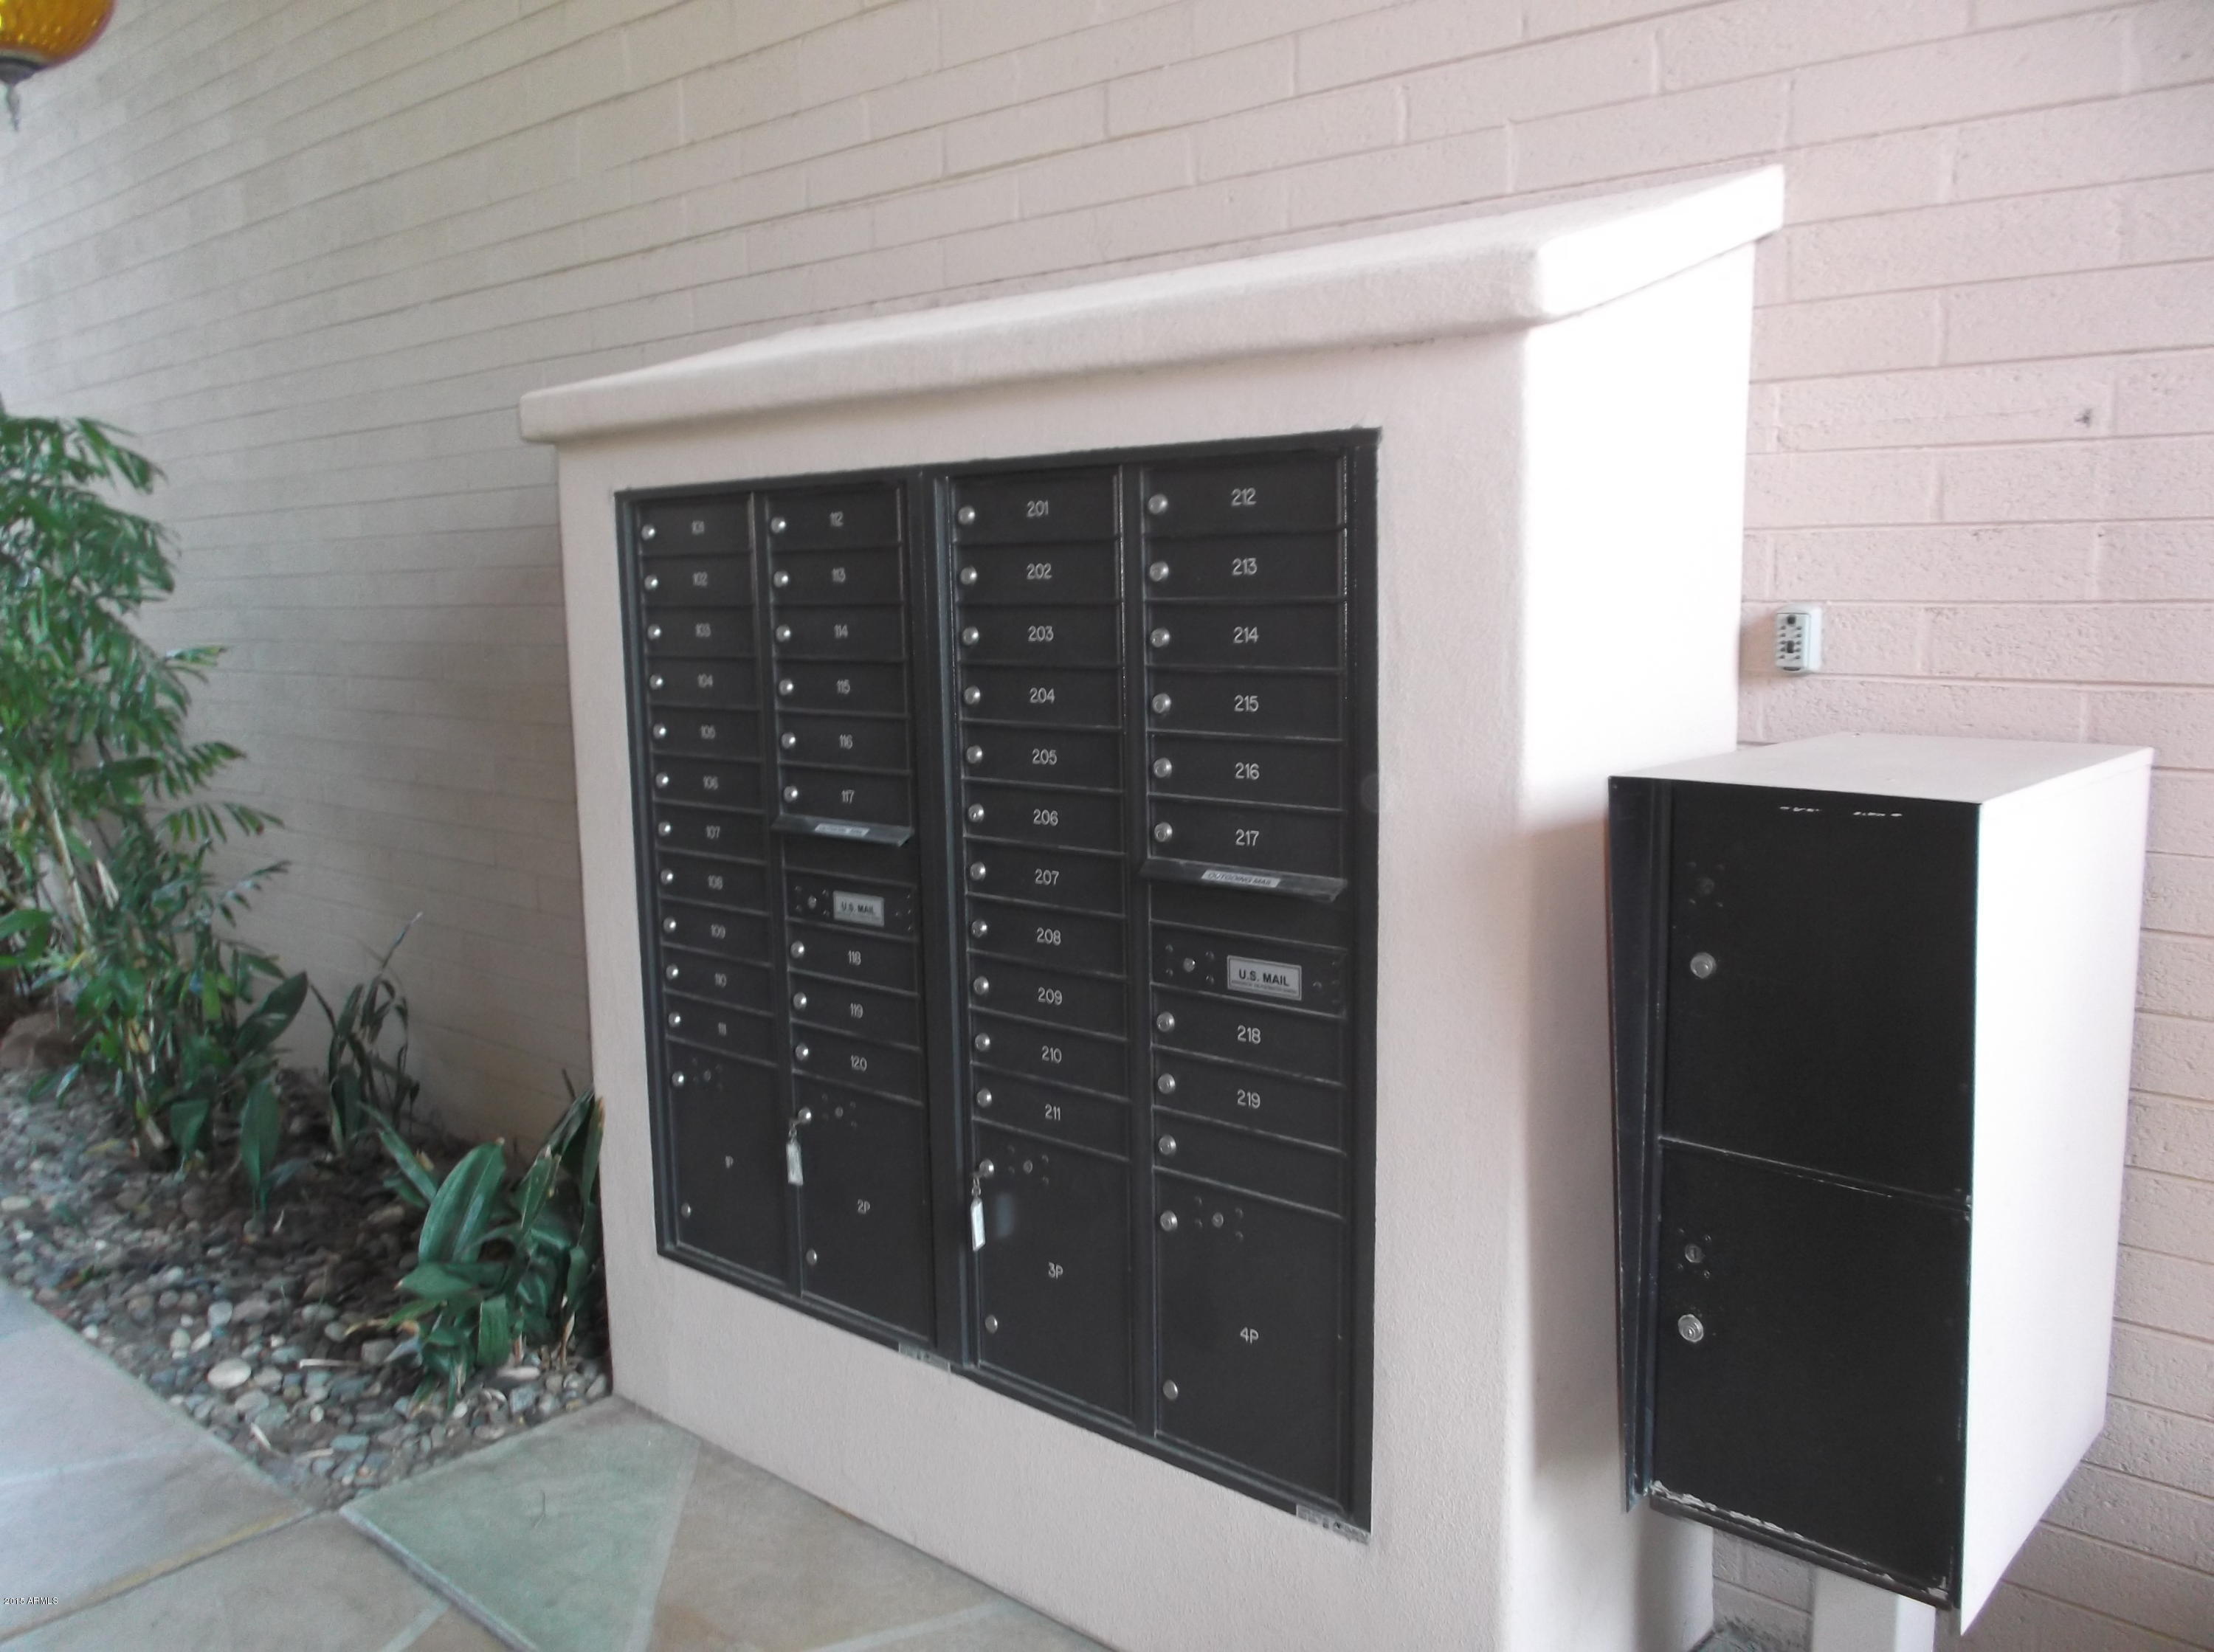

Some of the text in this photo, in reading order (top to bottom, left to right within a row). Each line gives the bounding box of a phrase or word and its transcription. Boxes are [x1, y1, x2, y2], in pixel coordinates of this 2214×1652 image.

[1231, 487, 1257, 507] 212
[1027, 500, 1049, 518] 201
[829, 511, 844, 528] 112
[1027, 562, 1052, 580] 202
[1232, 557, 1258, 576] 213
[692, 571, 708, 587] 102
[831, 567, 846, 584] 113
[833, 623, 849, 638] 114
[1028, 625, 1054, 642] 203
[1233, 626, 1259, 644] 214
[697, 673, 714, 688] 104
[835, 679, 851, 695] 115
[1030, 687, 1055, 704] 204
[1234, 694, 1259, 713] 215
[839, 733, 853, 750] 116
[1032, 748, 1058, 765] 205
[1235, 761, 1260, 781] 216
[841, 789, 855, 804] 117
[1033, 808, 1059, 826] 206
[706, 825, 721, 840] 107
[1235, 829, 1260, 846] 217
[1035, 868, 1060, 885] 207
[1036, 927, 1061, 946] 208
[847, 950, 862, 966] 118
[714, 972, 727, 988] 110
[1238, 969, 1260, 982] U.S.
[1263, 972, 1290, 987] MAIL
[1038, 986, 1063, 1006] 209
[849, 1003, 863, 1019] 119
[1237, 1025, 1261, 1045] 218
[850, 1054, 868, 1072] 120
[1041, 1045, 1062, 1064] 210
[1237, 1089, 1261, 1109] 219
[1044, 1103, 1061, 1121] 211
[857, 1199, 871, 1214] 2P
[1048, 1262, 1063, 1279] 3P
[1239, 1327, 1259, 1344] 4P
